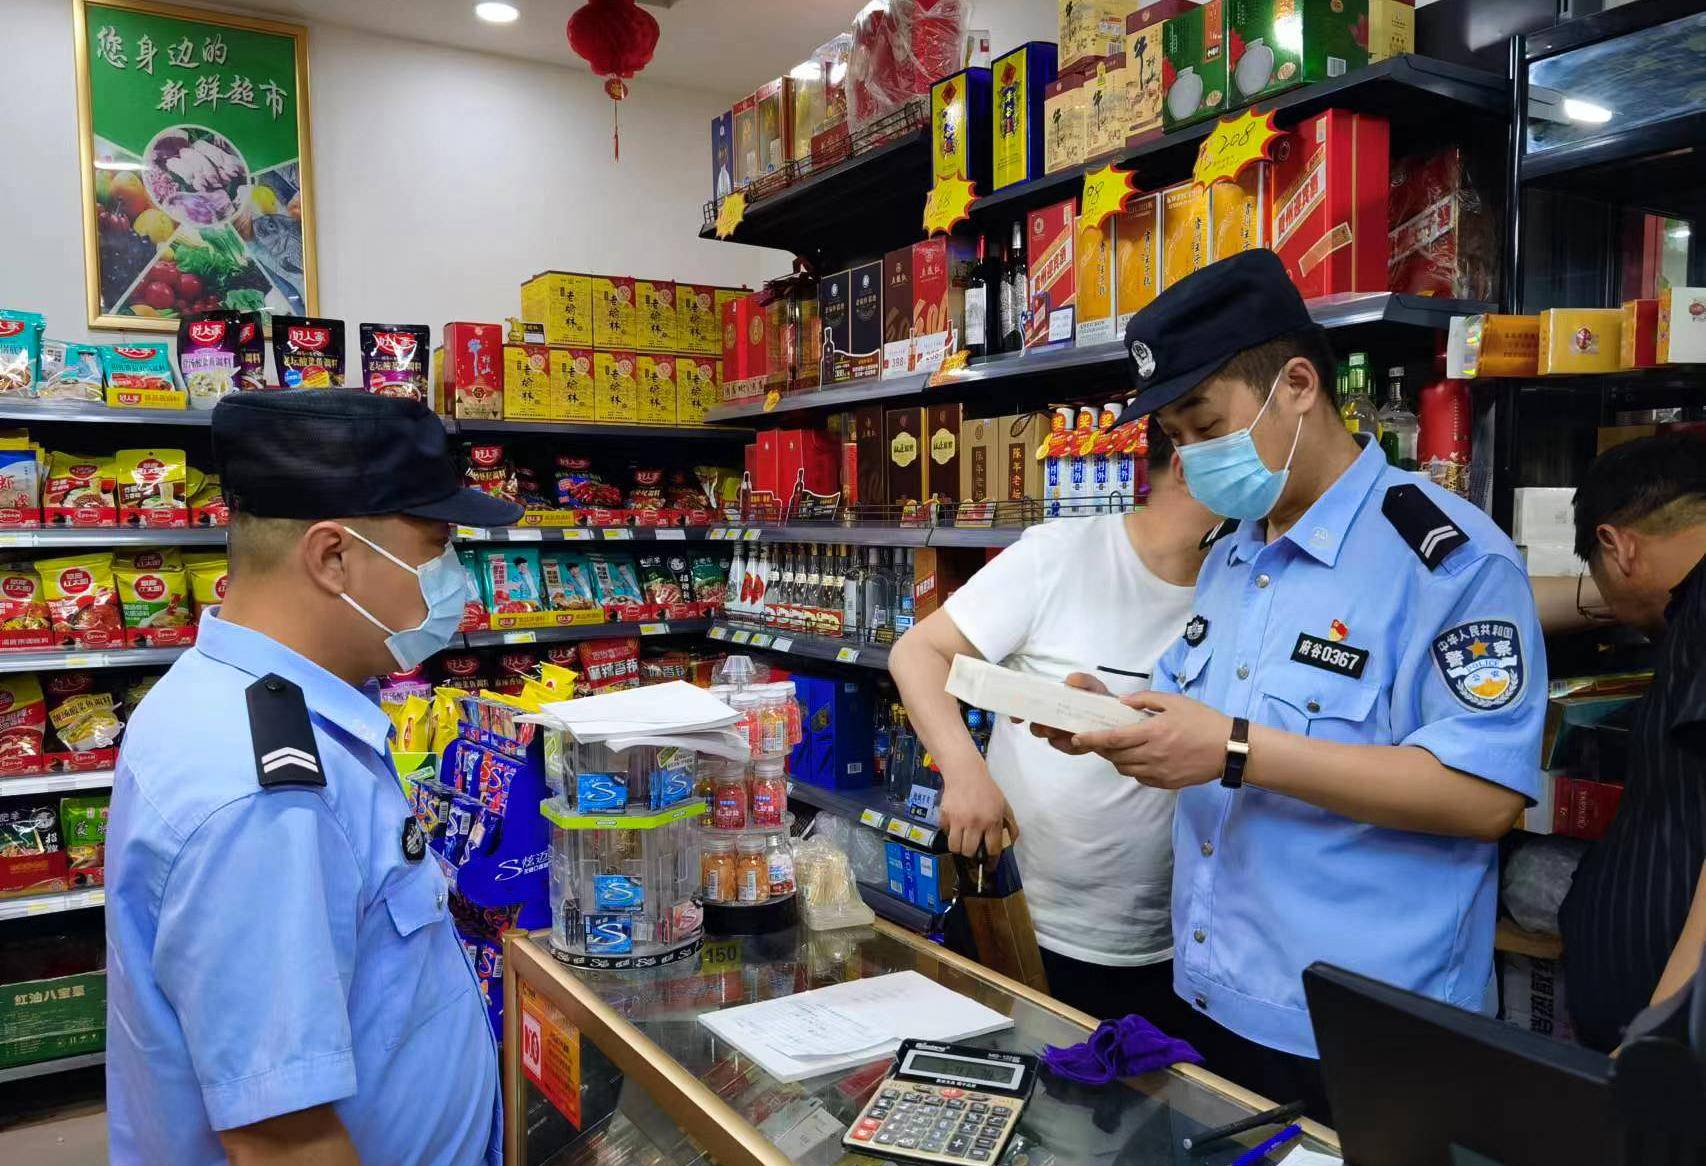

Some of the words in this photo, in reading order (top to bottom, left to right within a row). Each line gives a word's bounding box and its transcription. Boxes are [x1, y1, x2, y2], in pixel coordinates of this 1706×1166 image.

[97, 26, 228, 74] 您身边的
[155, 74, 288, 119] 新鲜超市
[1219, 122, 1256, 153] 208
[1438, 624, 1513, 651] 中华人民共和国
[1298, 640, 1360, 670] 府谷0367
